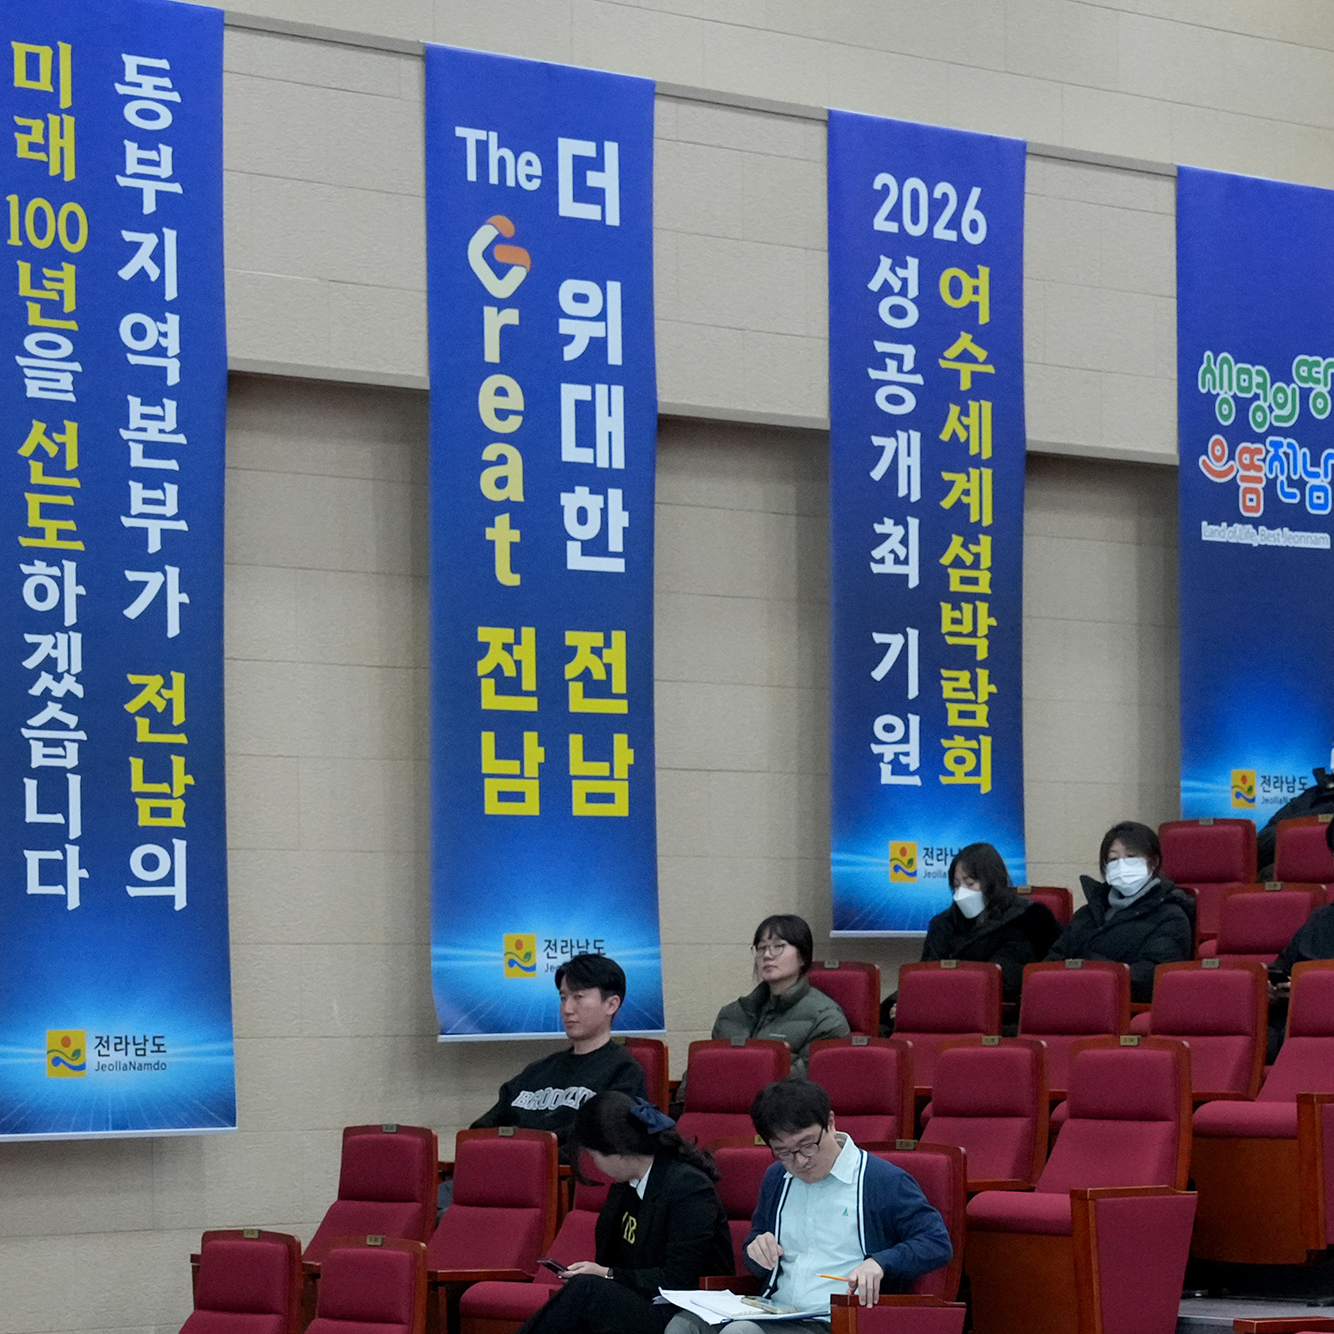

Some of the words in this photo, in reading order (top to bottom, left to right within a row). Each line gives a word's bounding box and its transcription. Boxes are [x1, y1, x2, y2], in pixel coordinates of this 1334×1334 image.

[10, 40, 76, 182] 미래
[454, 125, 543, 191] The
[557, 136, 621, 227] 더
[5, 193, 89, 403] 100년을
[872, 172, 988, 245] 2026
[114, 53, 191, 639] 동부지역본부가
[558, 278, 630, 573] 위대한
[938, 264, 998, 795] 여수세계섬박람회
[17, 419, 90, 911] 선도하겠습니다
[476, 626, 545, 816] 전남
[564, 630, 635, 817] 전남
[123, 670, 195, 911] 전남의
[94, 1034, 167, 1058] 전라남도
[94, 1060, 167, 1072] JeollaNamdo
